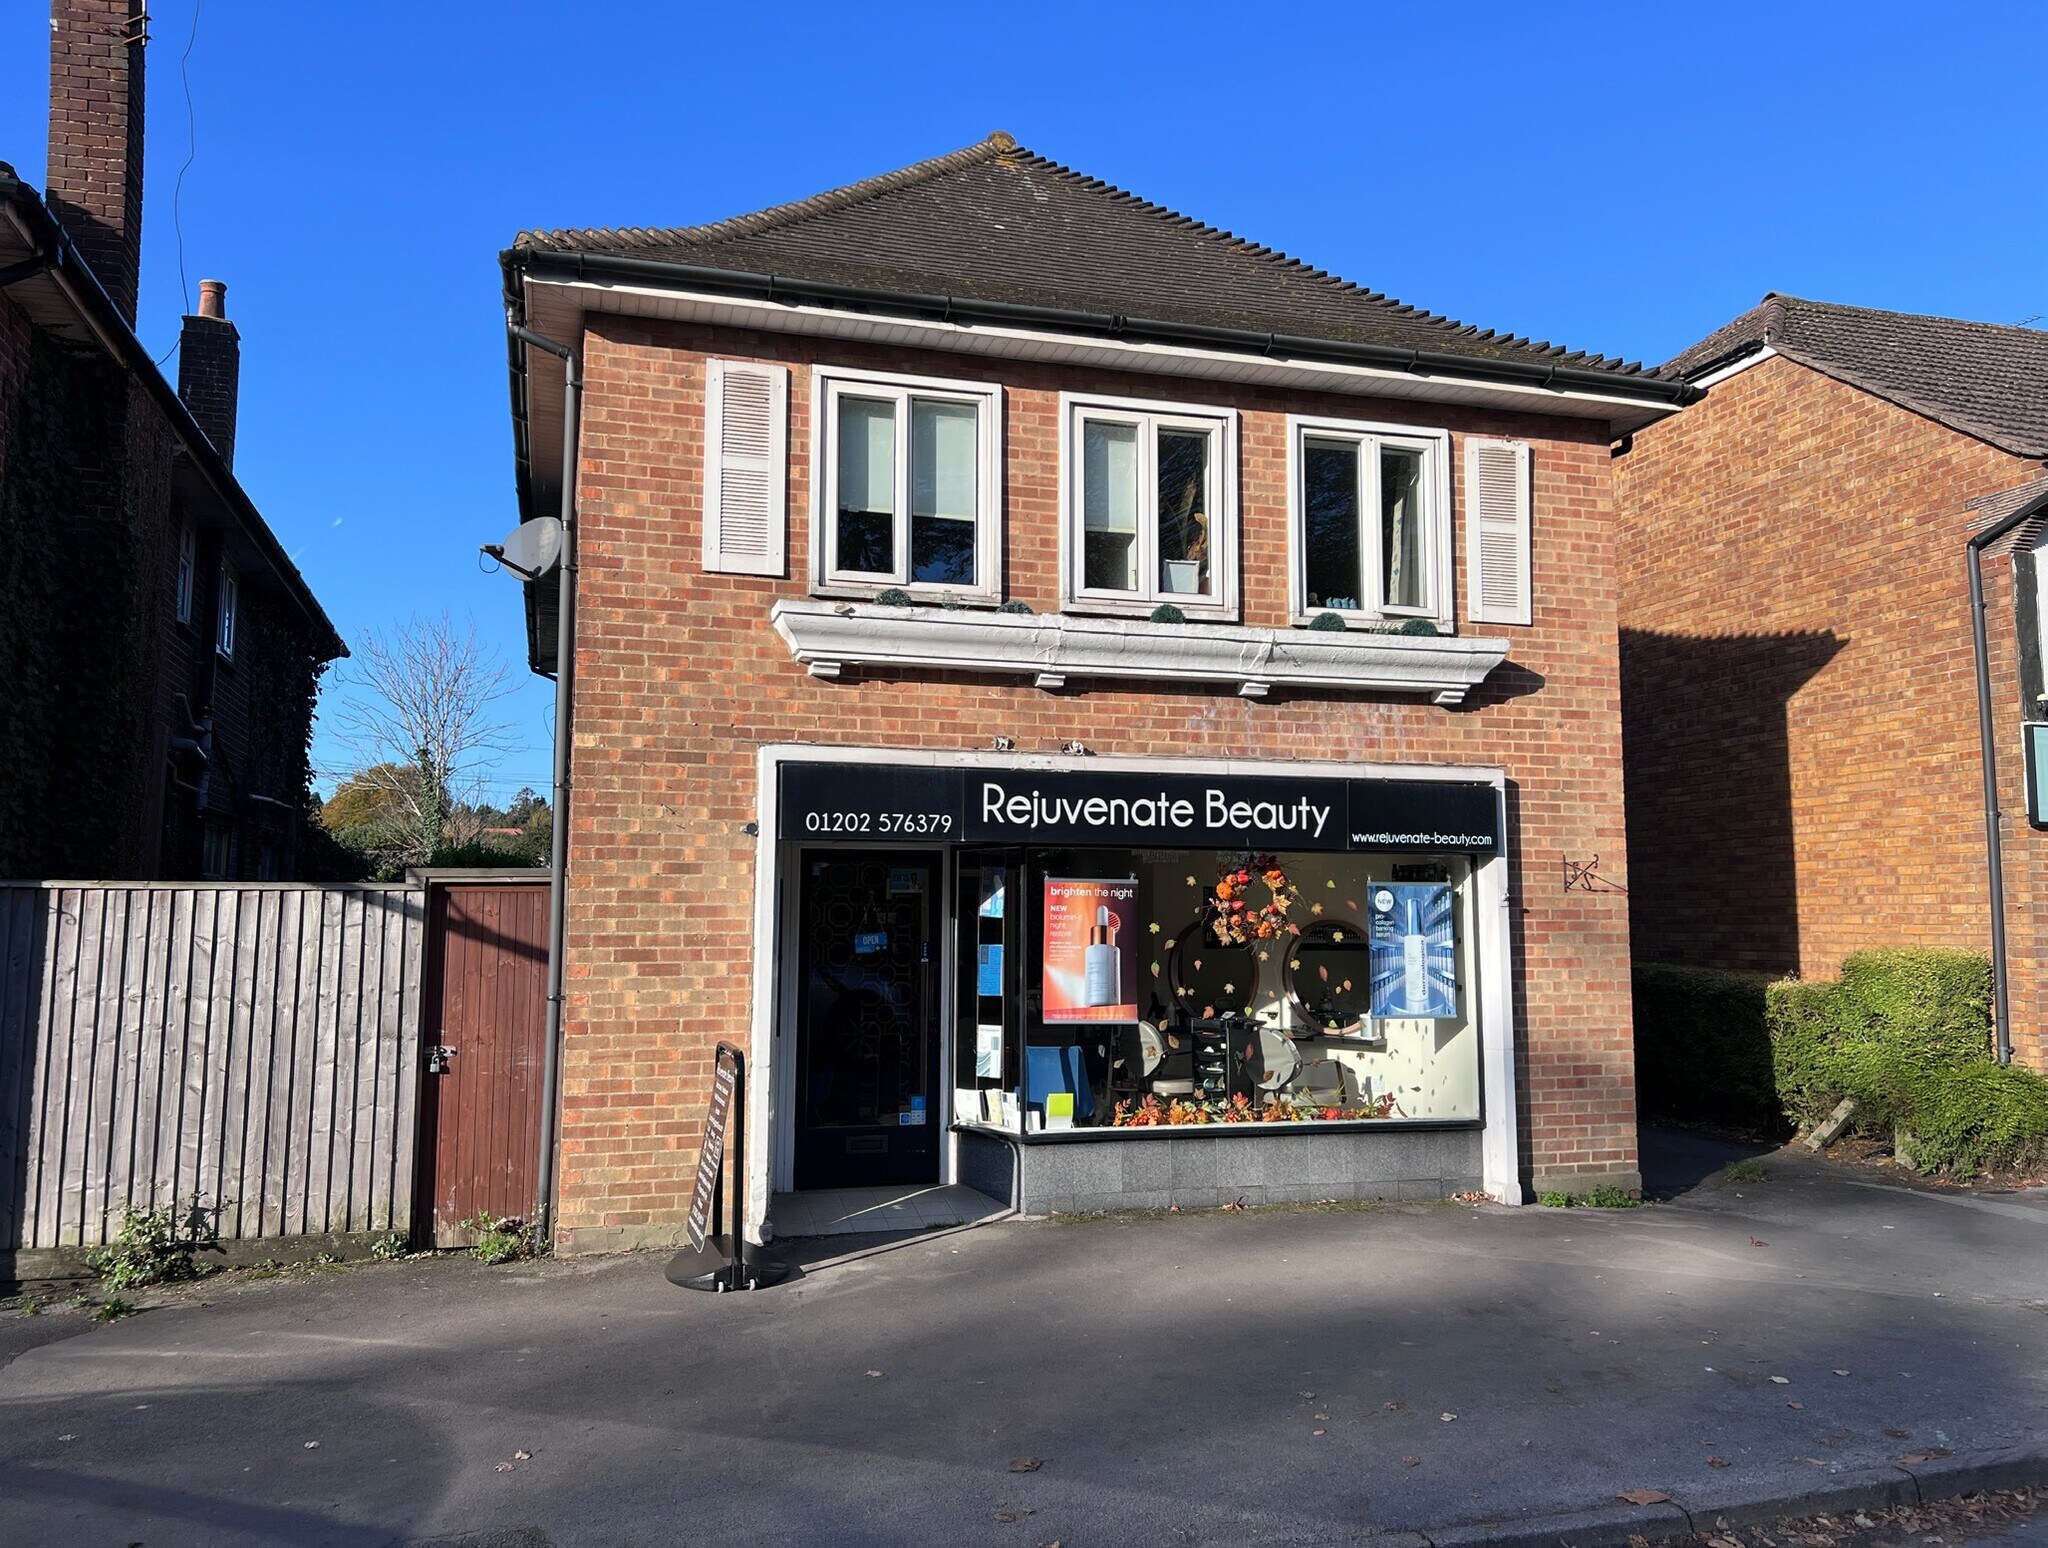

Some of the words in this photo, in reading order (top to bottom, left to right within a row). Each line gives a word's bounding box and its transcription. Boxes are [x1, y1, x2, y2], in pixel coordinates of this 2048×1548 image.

[982, 782, 1194, 829] Rejuvenate
[1205, 789, 1331, 838] Beauty
[805, 812, 871, 832] 01202
[878, 813, 953, 834] 576379
[1352, 832, 1492, 847] www.rejuvenate-beauty.com
[1050, 886, 1091, 898] brighten
[1094, 887, 1108, 897] the
[1110, 887, 1133, 900] night
[863, 935, 879, 945] OPEN
